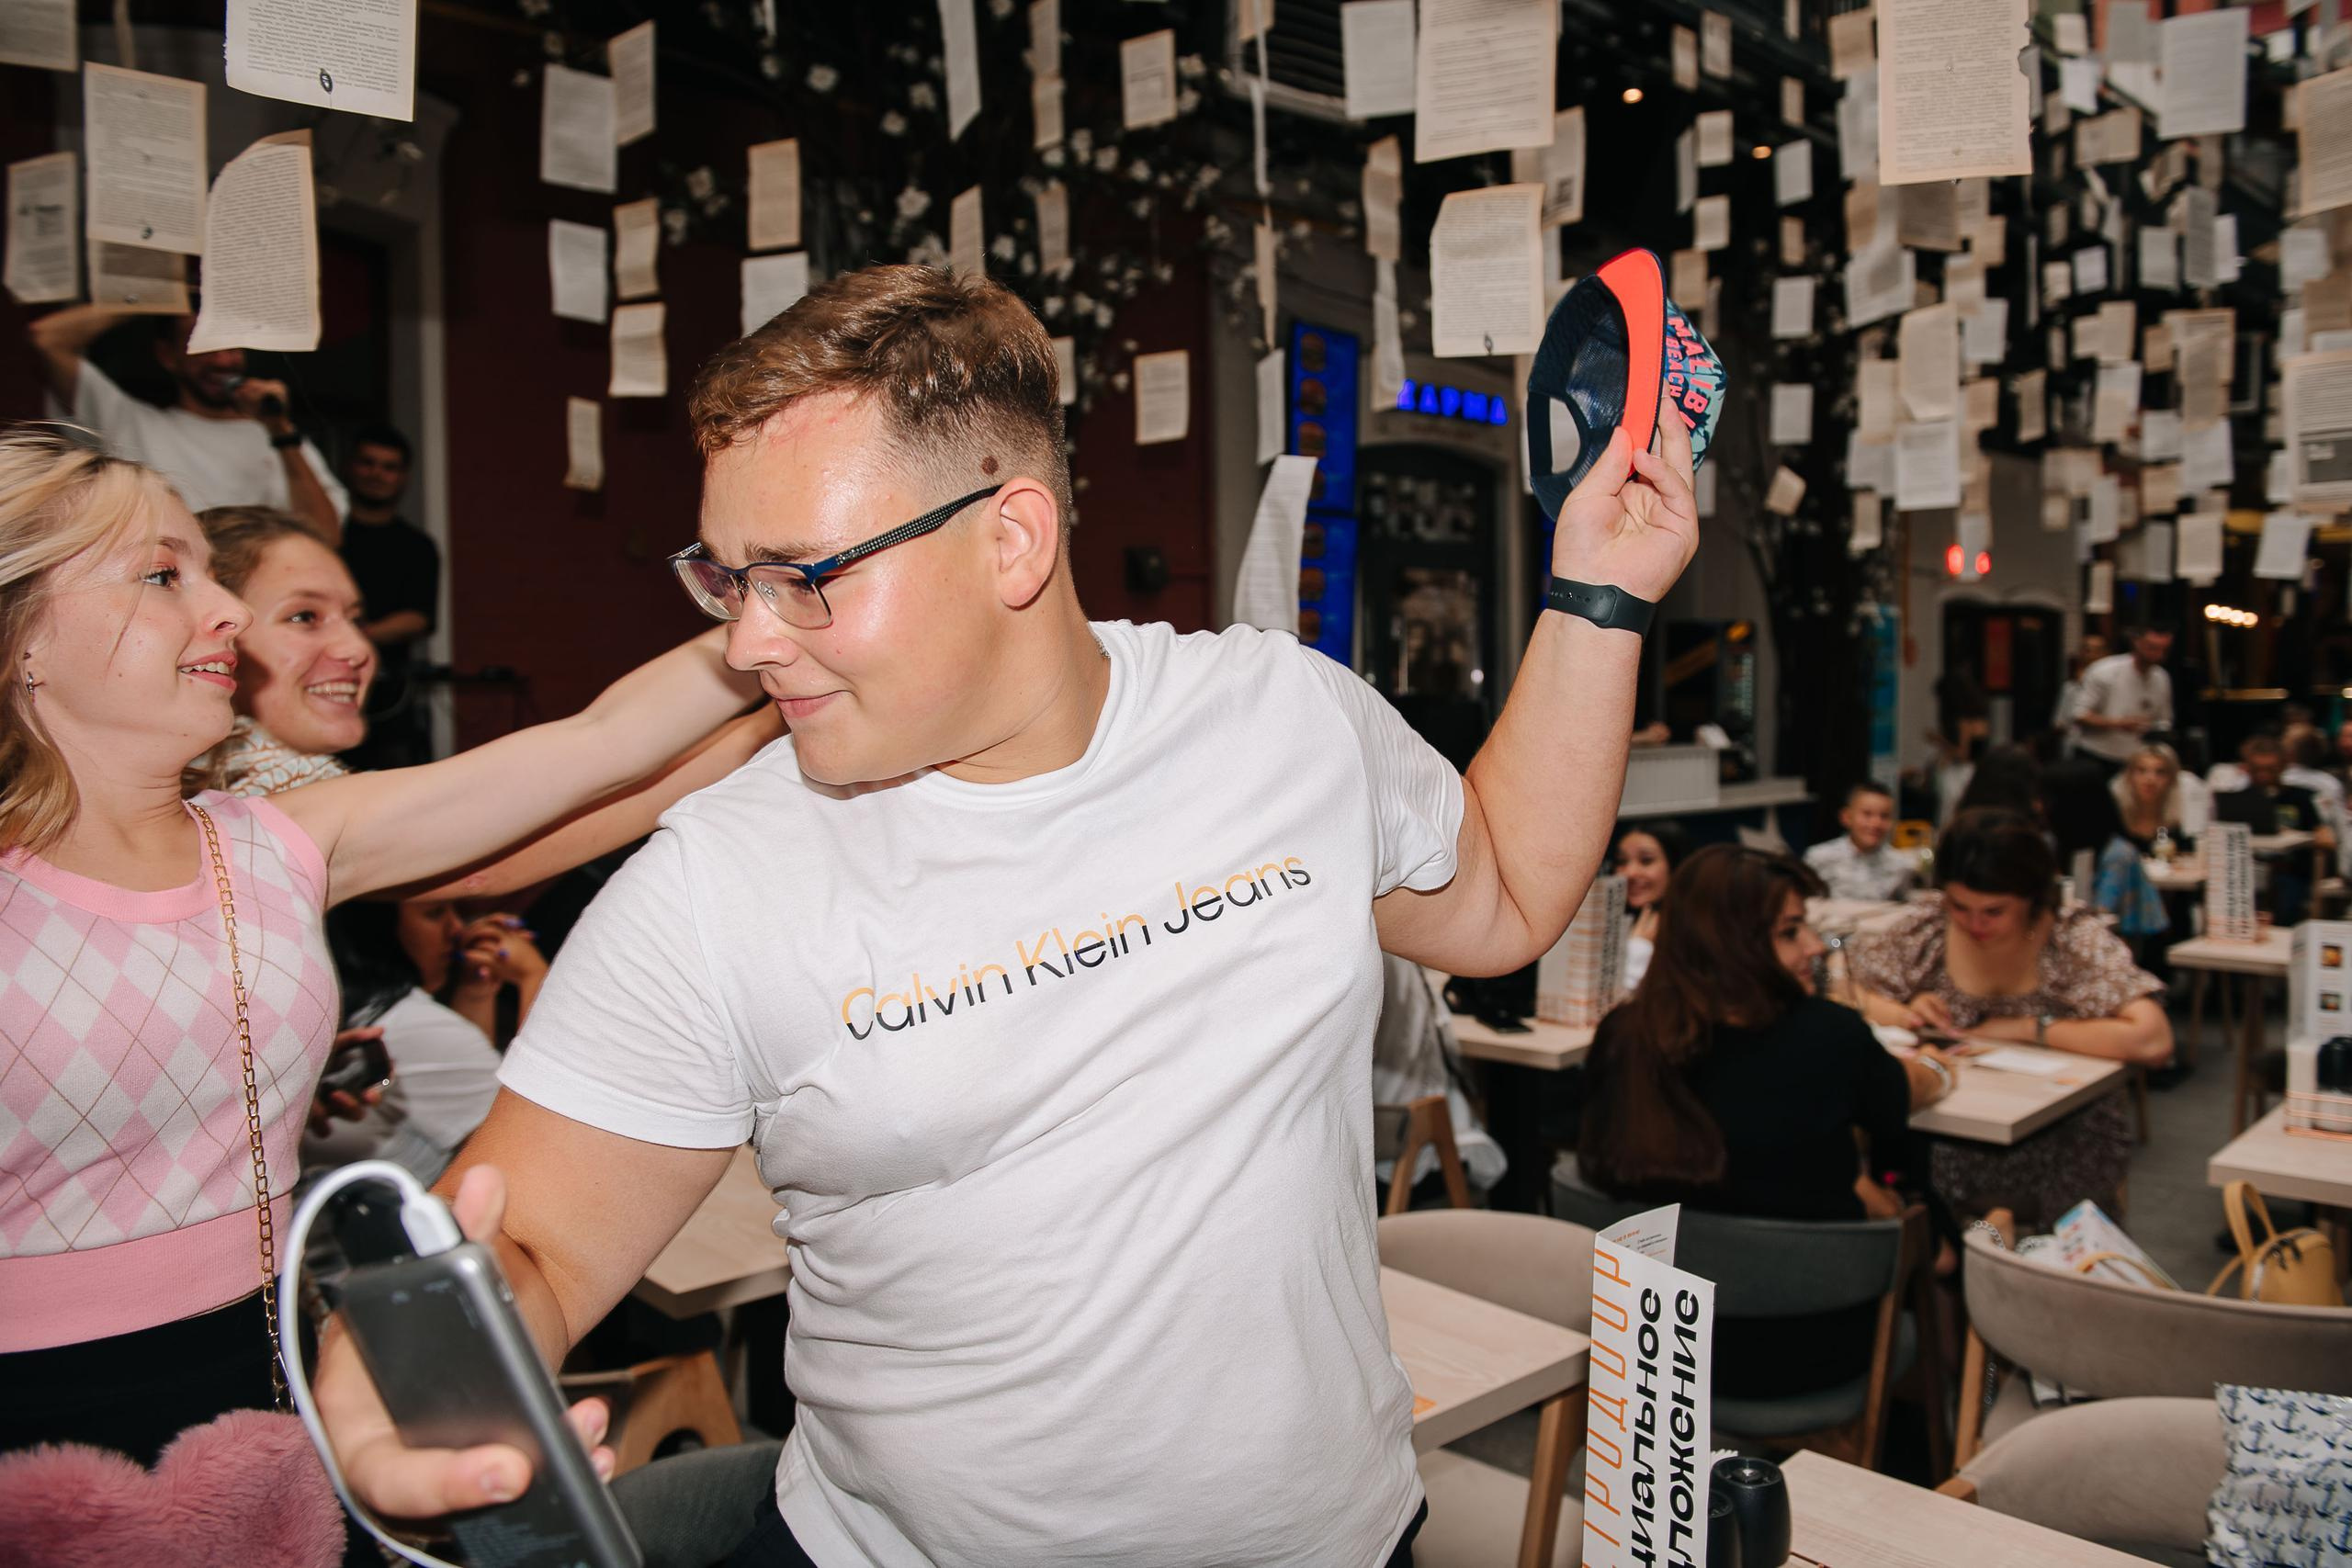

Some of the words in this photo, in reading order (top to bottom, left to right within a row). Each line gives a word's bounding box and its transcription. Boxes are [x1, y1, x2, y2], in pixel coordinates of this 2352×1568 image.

[1666, 338, 1686, 398] BEACH
[842, 963, 1013, 1041] Calvin
[1015, 911, 1152, 987] Klein
[1163, 854, 1313, 935] Jeans
